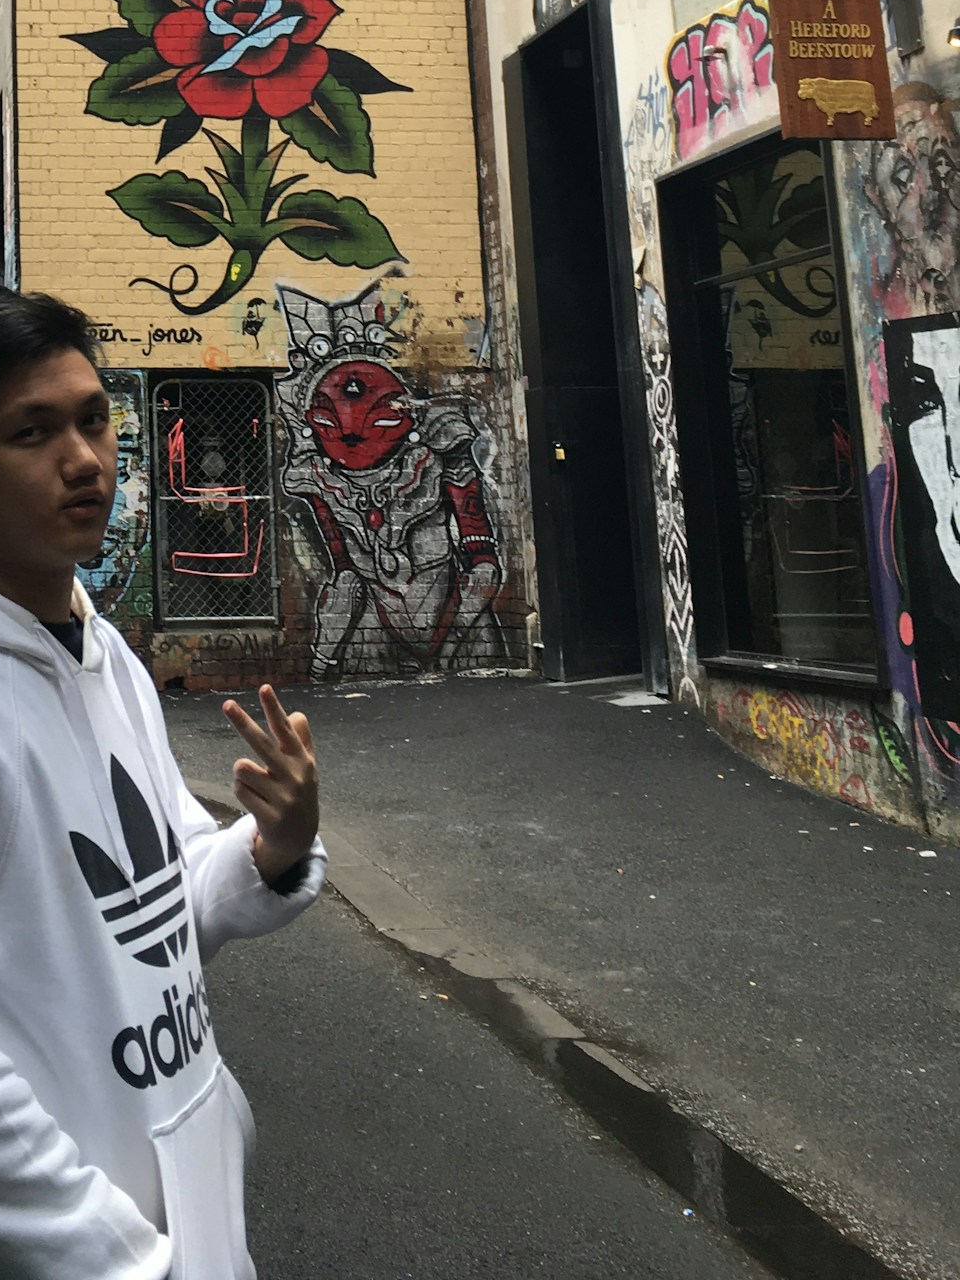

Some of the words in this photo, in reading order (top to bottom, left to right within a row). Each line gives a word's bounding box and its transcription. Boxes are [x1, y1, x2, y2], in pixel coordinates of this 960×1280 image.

[822, 0, 837, 20] A
[790, 20, 871, 38] HEREFORD
[788, 40, 876, 60] BEEFSTOUW
